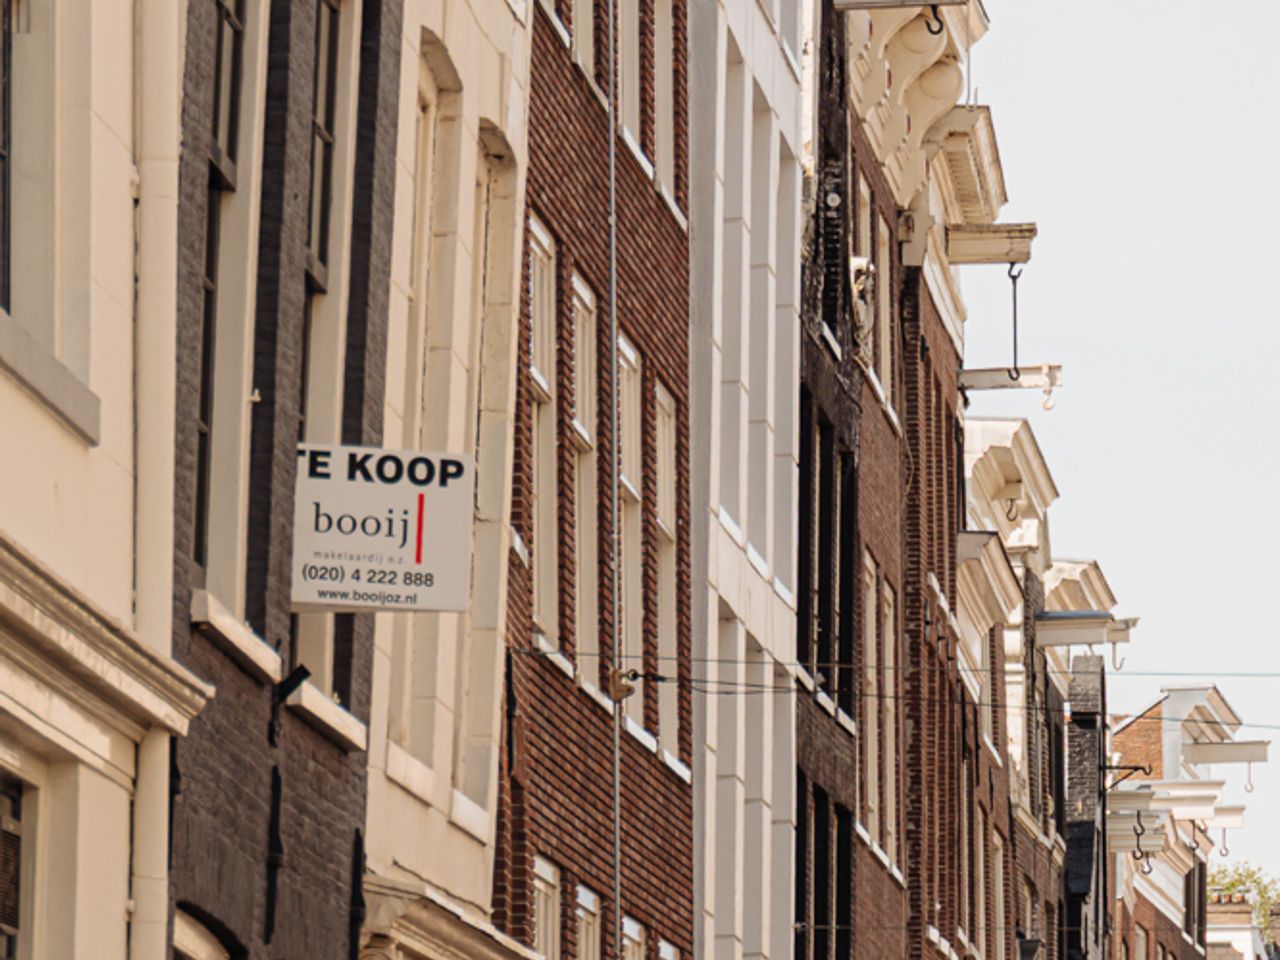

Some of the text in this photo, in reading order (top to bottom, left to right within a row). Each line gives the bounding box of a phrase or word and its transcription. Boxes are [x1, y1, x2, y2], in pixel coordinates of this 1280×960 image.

[347, 452, 464, 487] KOOP
[313, 501, 409, 549] booij
[302, 564, 434, 587] (020) 4 222 888
[317, 588, 418, 605] www.booijoz.nl
